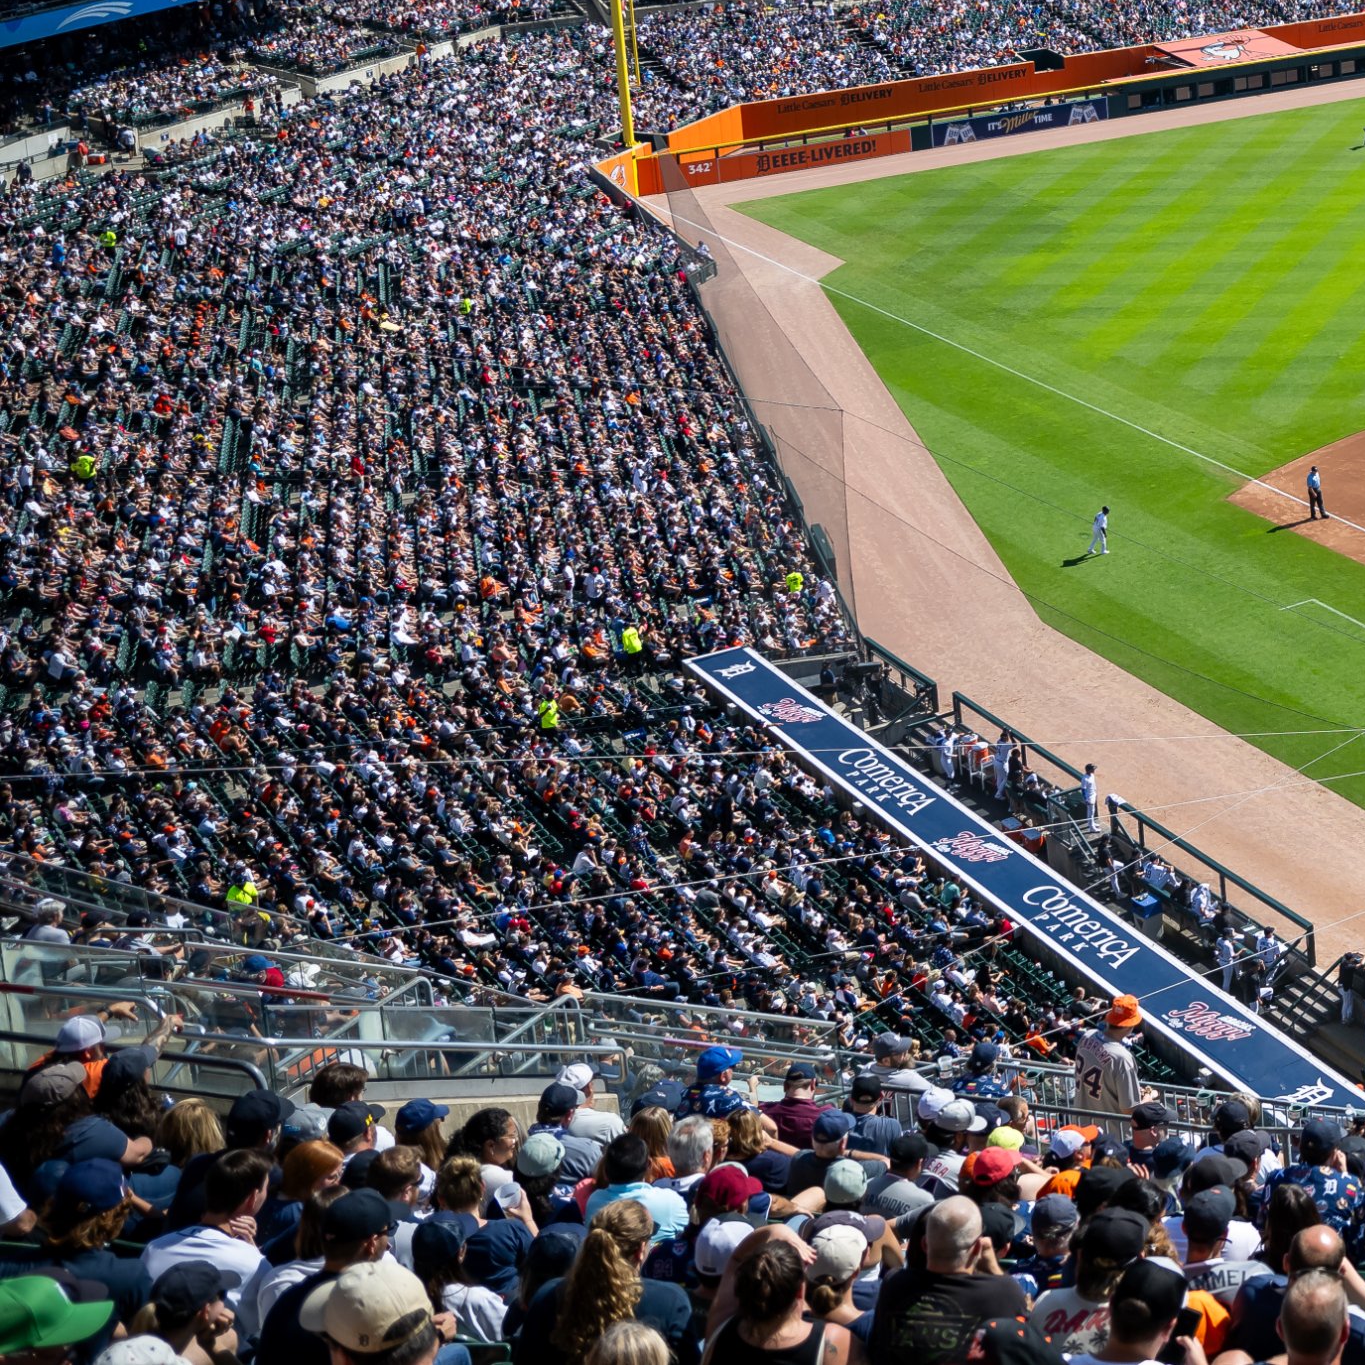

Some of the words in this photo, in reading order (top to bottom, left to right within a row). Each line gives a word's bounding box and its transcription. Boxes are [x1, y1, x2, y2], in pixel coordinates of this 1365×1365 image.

[918, 80, 940, 93] Little
[941, 77, 974, 90] Caesars
[777, 100, 800, 114] Little
[801, 97, 835, 112] Caesars
[1000, 109, 1039, 134] Miller
[1034, 114, 1053, 125] TIME
[688, 162, 713, 175] 342'
[845, 770, 895, 806] PARK
[1036, 912, 1087, 954] PARK
